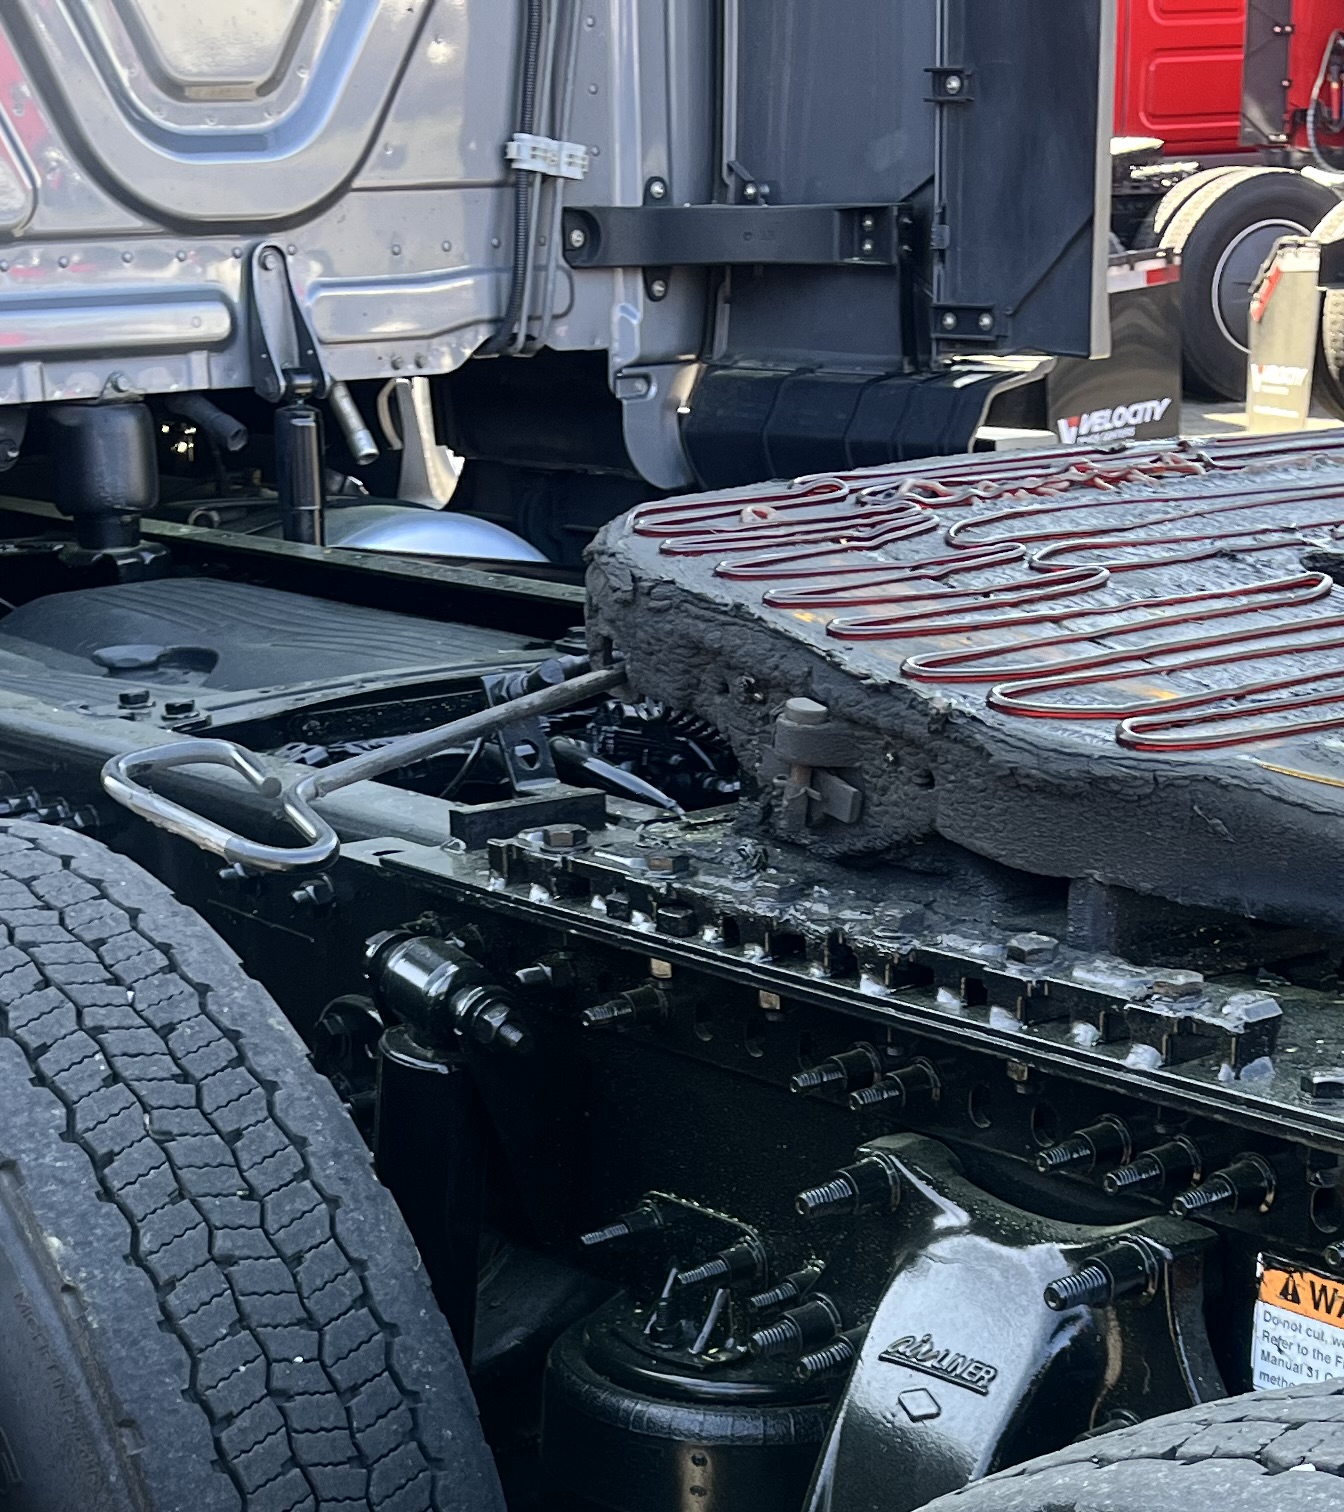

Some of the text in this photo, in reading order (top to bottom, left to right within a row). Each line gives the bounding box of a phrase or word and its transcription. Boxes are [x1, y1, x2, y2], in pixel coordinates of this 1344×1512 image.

[1079, 398, 1172, 435] VELOCITY
[1263, 1310, 1279, 1326] Do
[1280, 1317, 1303, 1335] not
[1262, 1330, 1293, 1350] Refer
[1297, 1343, 1308, 1356] to
[1312, 1348, 1332, 1364] the
[1260, 1350, 1303, 1375] Manual
